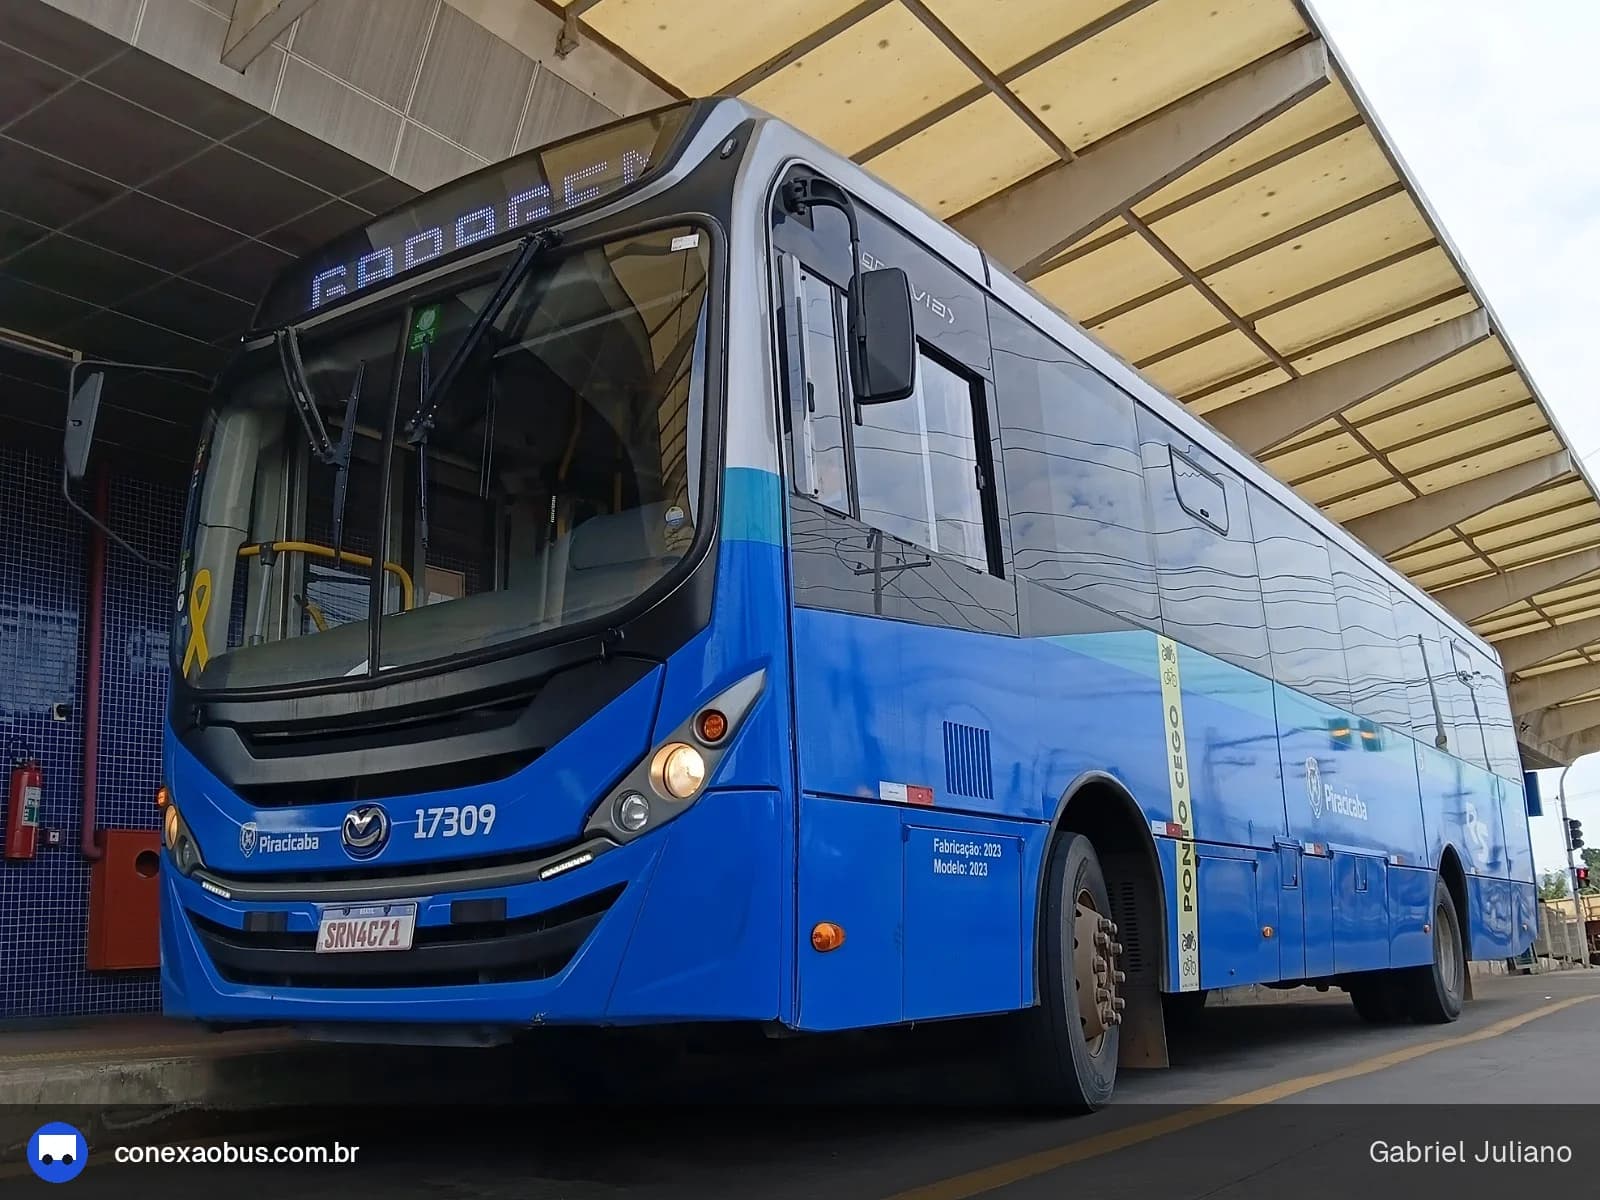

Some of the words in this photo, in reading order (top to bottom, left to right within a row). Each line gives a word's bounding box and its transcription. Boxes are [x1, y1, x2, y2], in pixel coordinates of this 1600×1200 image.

[1169, 704, 1185, 789] CEGO
[1324, 783, 1368, 821] Piracicaba
[414, 803, 496, 839] 17309
[259, 833, 319, 854] Piracicaba
[933, 837, 982, 858] Fabricação:
[983, 842, 1002, 858] 2023
[933, 858, 968, 875] Modelo:
[969, 861, 988, 877] 2023
[324, 919, 401, 949] SRN4C71
